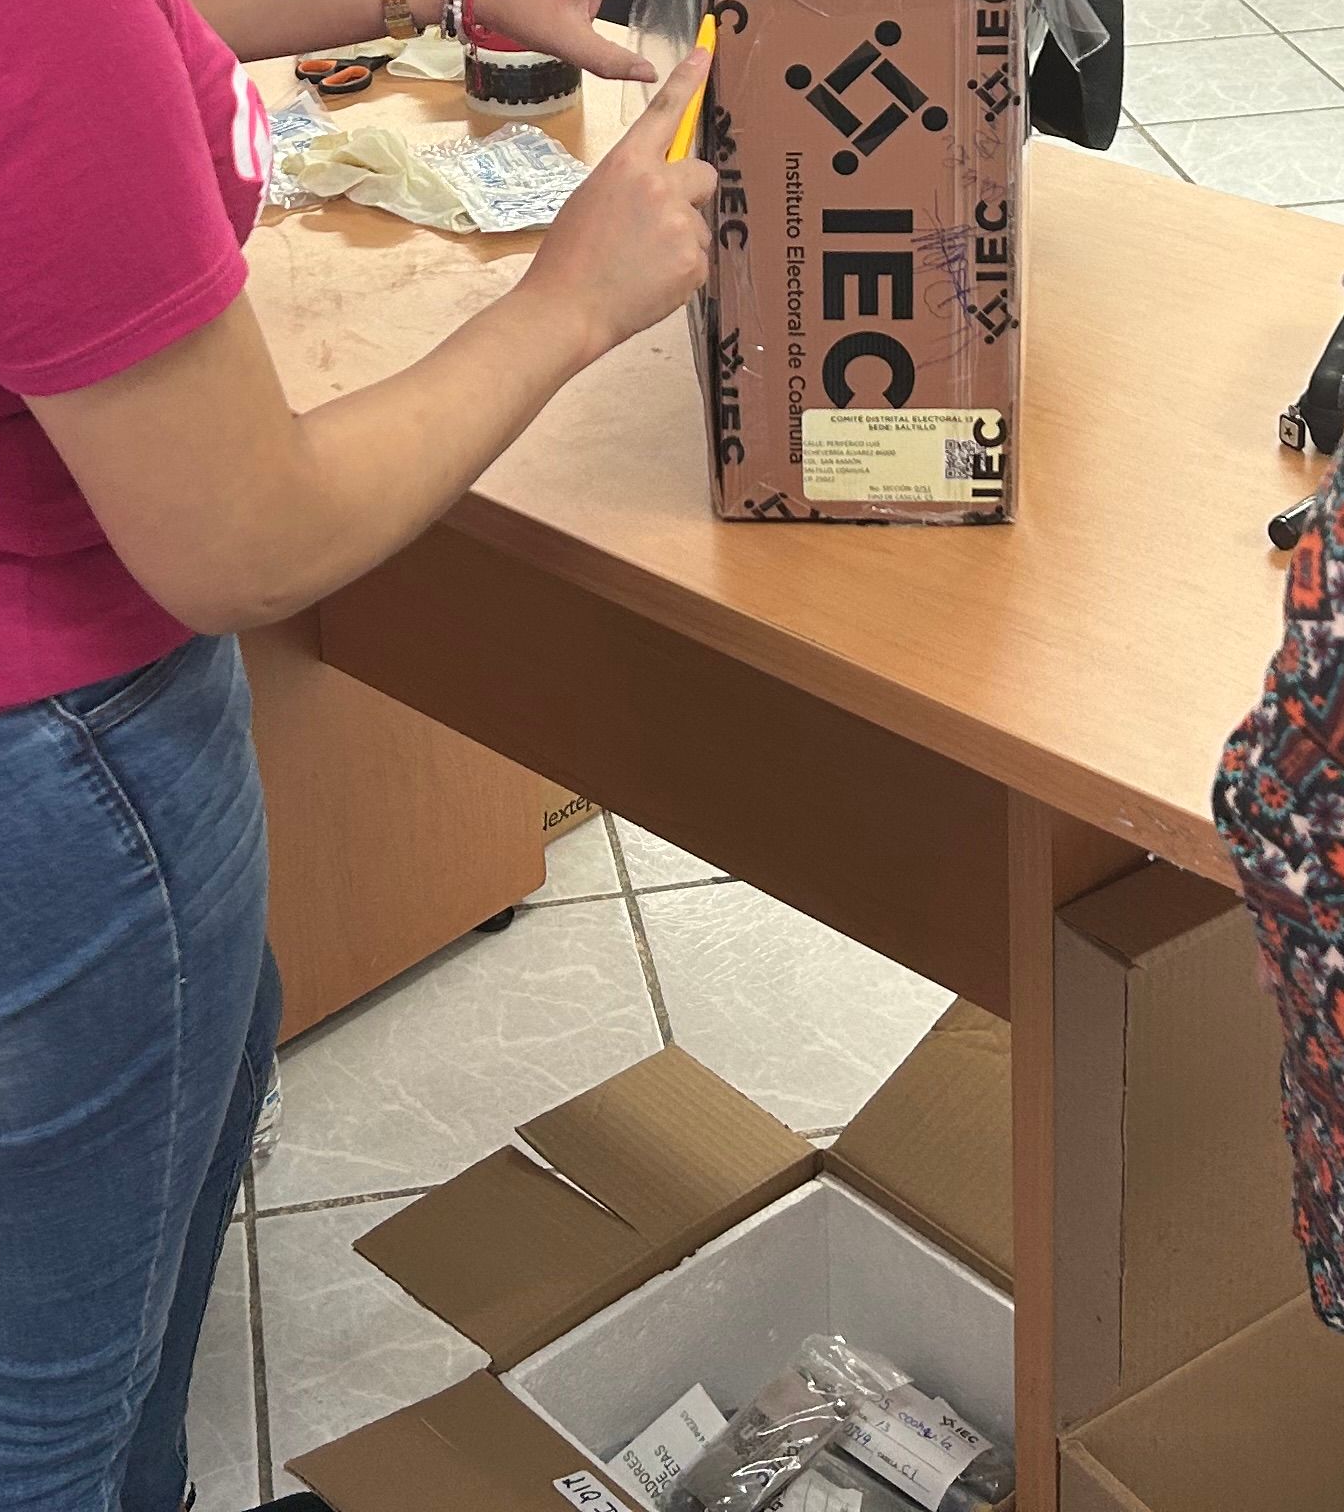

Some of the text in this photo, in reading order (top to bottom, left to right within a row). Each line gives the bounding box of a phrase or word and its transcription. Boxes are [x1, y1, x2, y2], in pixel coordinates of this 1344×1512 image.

[719, 169, 749, 251] IEC
[785, 151, 804, 239] Instituto
[975, 199, 1008, 282] IEC
[786, 246, 805, 335] Electoral
[822, 209, 915, 409] IEC
[788, 341, 806, 369] de
[719, 388, 746, 466] IEC
[830, 414, 864, 424] COMITÉ
[865, 414, 909, 423] DISTRITAL
[911, 414, 964, 423] ELECTORAL
[895, 423, 936, 431] SALTILLO
[971, 417, 1007, 499] IEC
[622, 1449, 664, 1500] ADORES
[654, 1444, 682, 1479] ETAS
[954, 1426, 979, 1445] IEC
